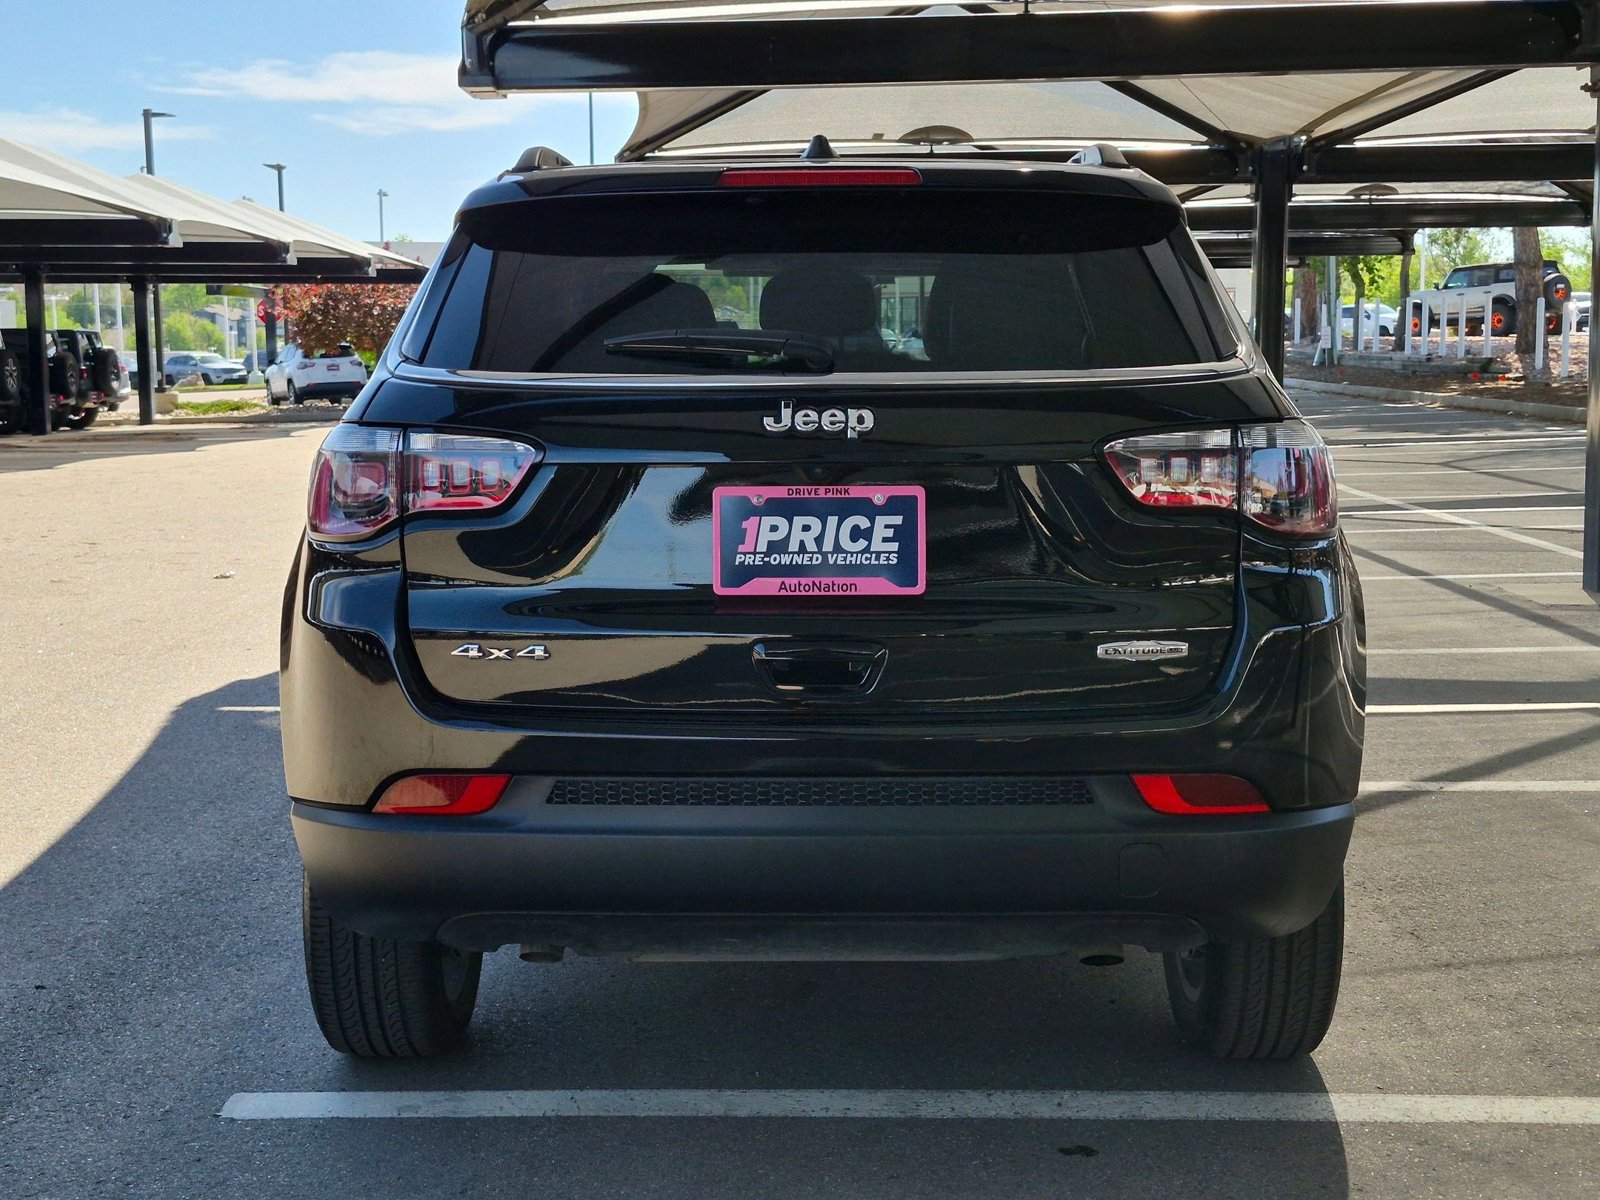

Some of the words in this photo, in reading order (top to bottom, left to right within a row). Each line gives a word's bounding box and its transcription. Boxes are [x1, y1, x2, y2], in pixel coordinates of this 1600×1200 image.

[763, 400, 875, 439] Jeep
[787, 488, 820, 496] DRIVE
[824, 487, 851, 496] PINK
[737, 515, 904, 553] 1PRICE
[735, 553, 822, 566] PRE-OWNED
[827, 553, 899, 565] VEHICLES
[778, 580, 858, 593] AutoNation
[450, 643, 550, 660] 4x4
[1104, 647, 1166, 655] LATITUDE
